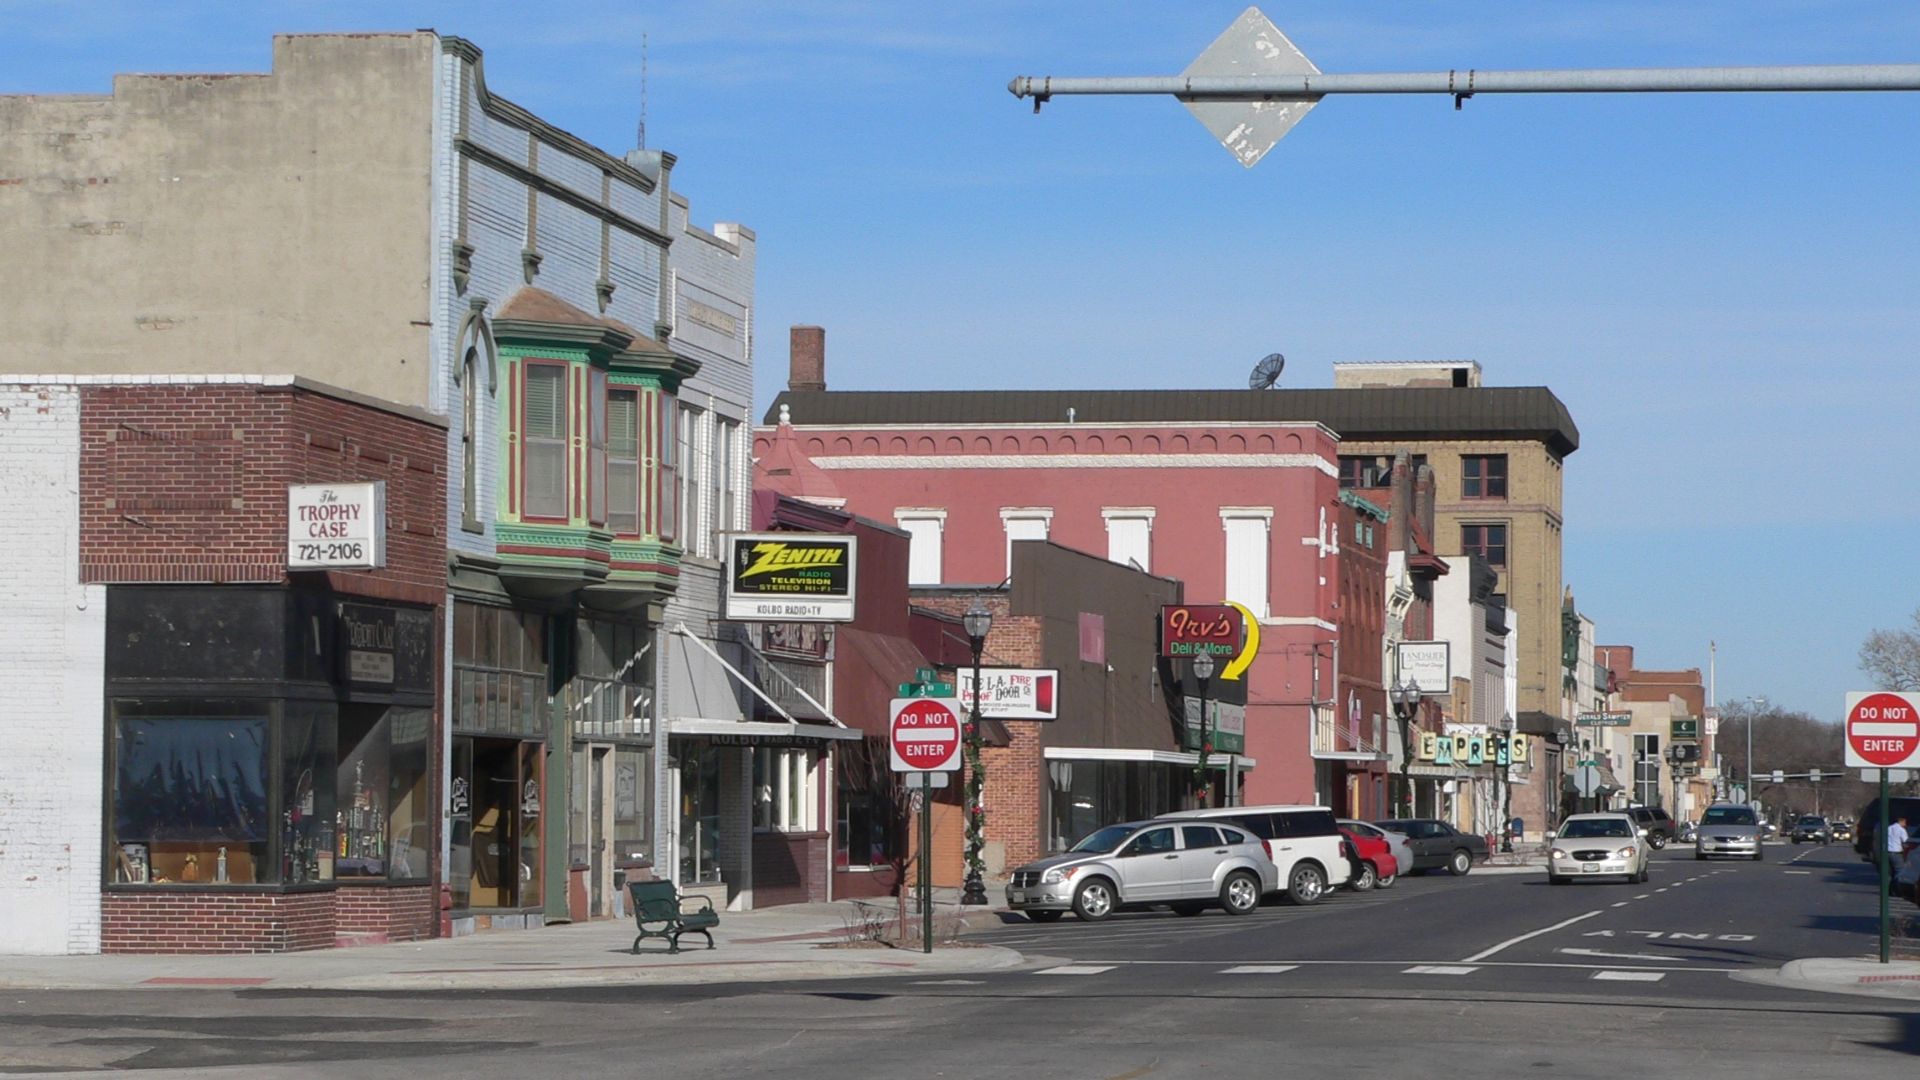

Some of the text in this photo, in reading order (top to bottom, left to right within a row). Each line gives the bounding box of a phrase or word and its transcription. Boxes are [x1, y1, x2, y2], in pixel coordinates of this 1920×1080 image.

[319, 489, 338, 503] The
[298, 504, 361, 521] TROPHY
[308, 521, 349, 538] CASE
[297, 543, 363, 560] 721-2106
[739, 543, 843, 579] ZENITH
[799, 570, 832, 578] RADIO
[771, 577, 832, 585] TELEVISION
[804, 584, 831, 592] HI-FI
[757, 604, 783, 615] KOLBO
[1169, 608, 1231, 638] Irv's
[1170, 642, 1192, 655] Deli
[1204, 643, 1233, 655] More
[962, 675, 984, 690] TE
[1010, 675, 1032, 686] FIRE
[962, 688, 992, 701] PROF
[995, 686, 1020, 701] DOOR
[901, 713, 950, 725] DO NOT
[1860, 707, 1908, 720] DO NOT
[906, 744, 945, 757] ENTER
[1863, 740, 1905, 752] ENTER
[1582, 930, 1757, 941] ONLY
